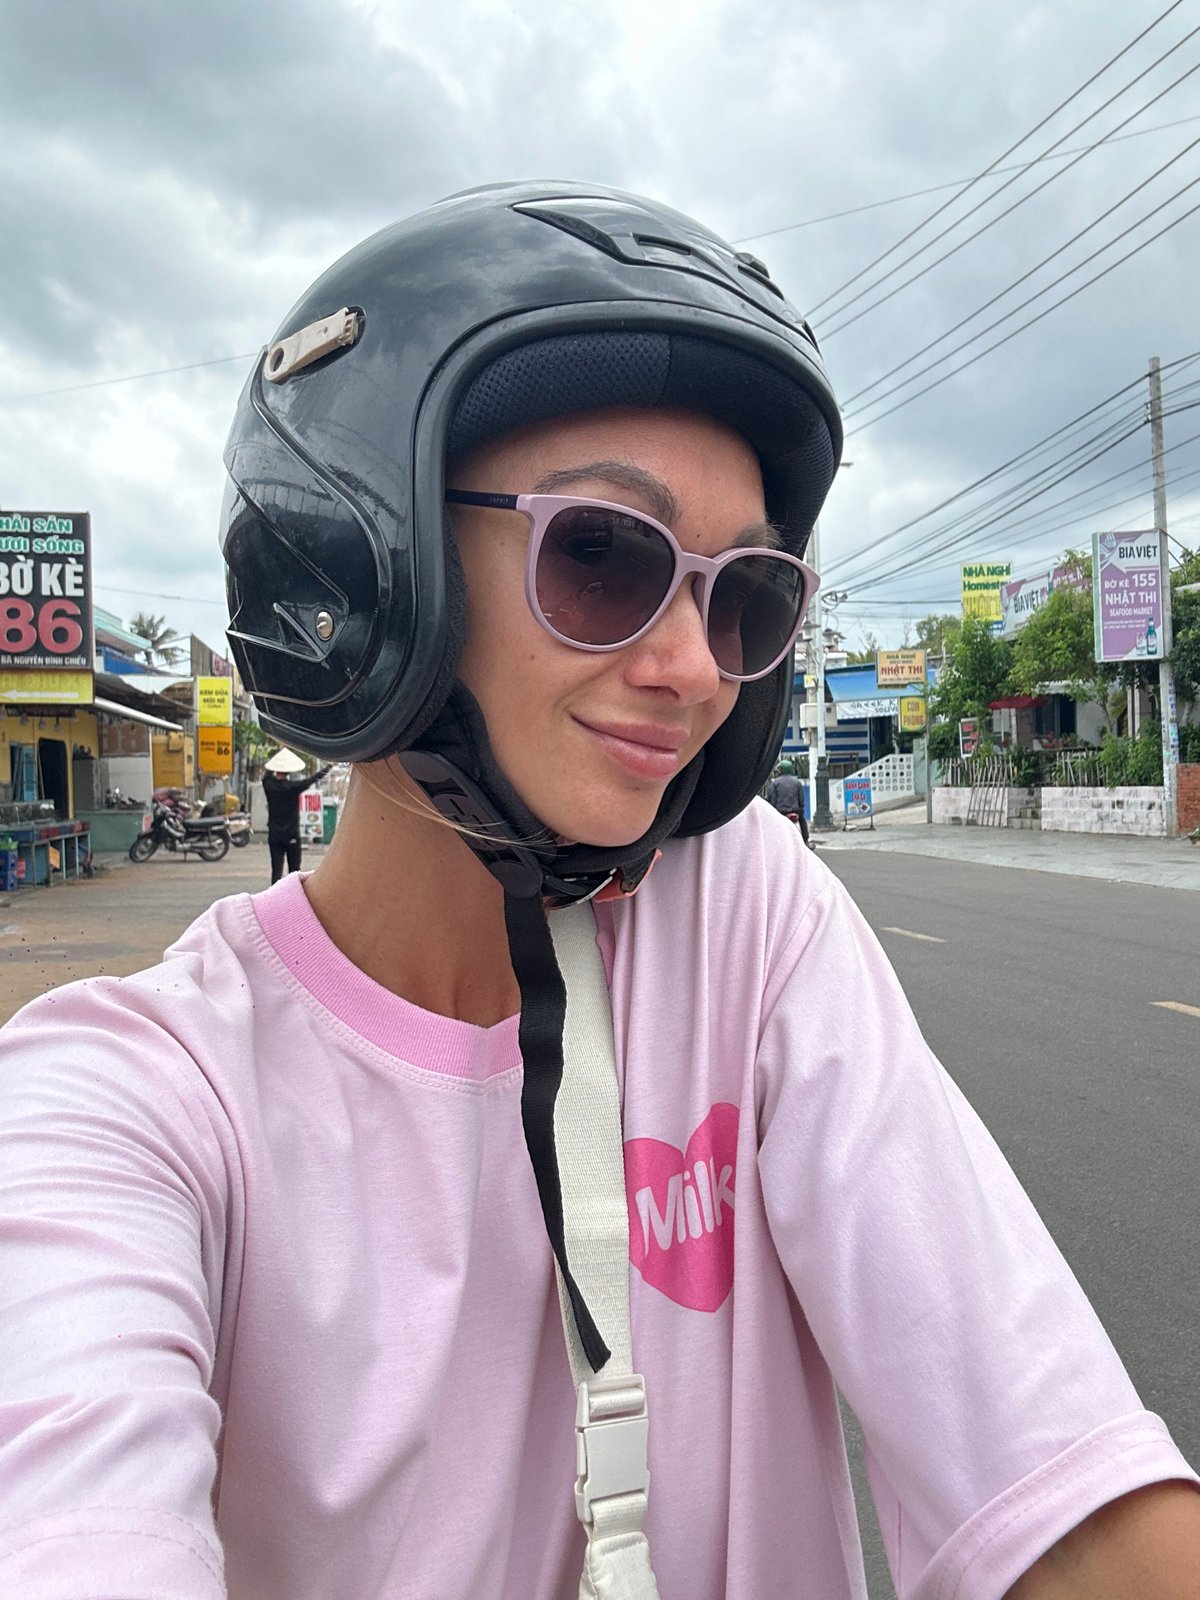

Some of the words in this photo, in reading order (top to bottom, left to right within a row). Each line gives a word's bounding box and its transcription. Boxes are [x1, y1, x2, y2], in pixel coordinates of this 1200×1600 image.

[33, 535, 84, 555] SỐNG
[1118, 546, 1135, 559] BIA
[1135, 544, 1158, 560] VIỆT
[41, 557, 84, 597] KÈ
[1132, 573, 1156, 587] 155
[963, 581, 1011, 591] Homest
[1105, 590, 1136, 607] NHẬT
[1138, 591, 1156, 603] THI
[907, 665, 923, 674] THI
[636, 1156, 735, 1258] Milk
